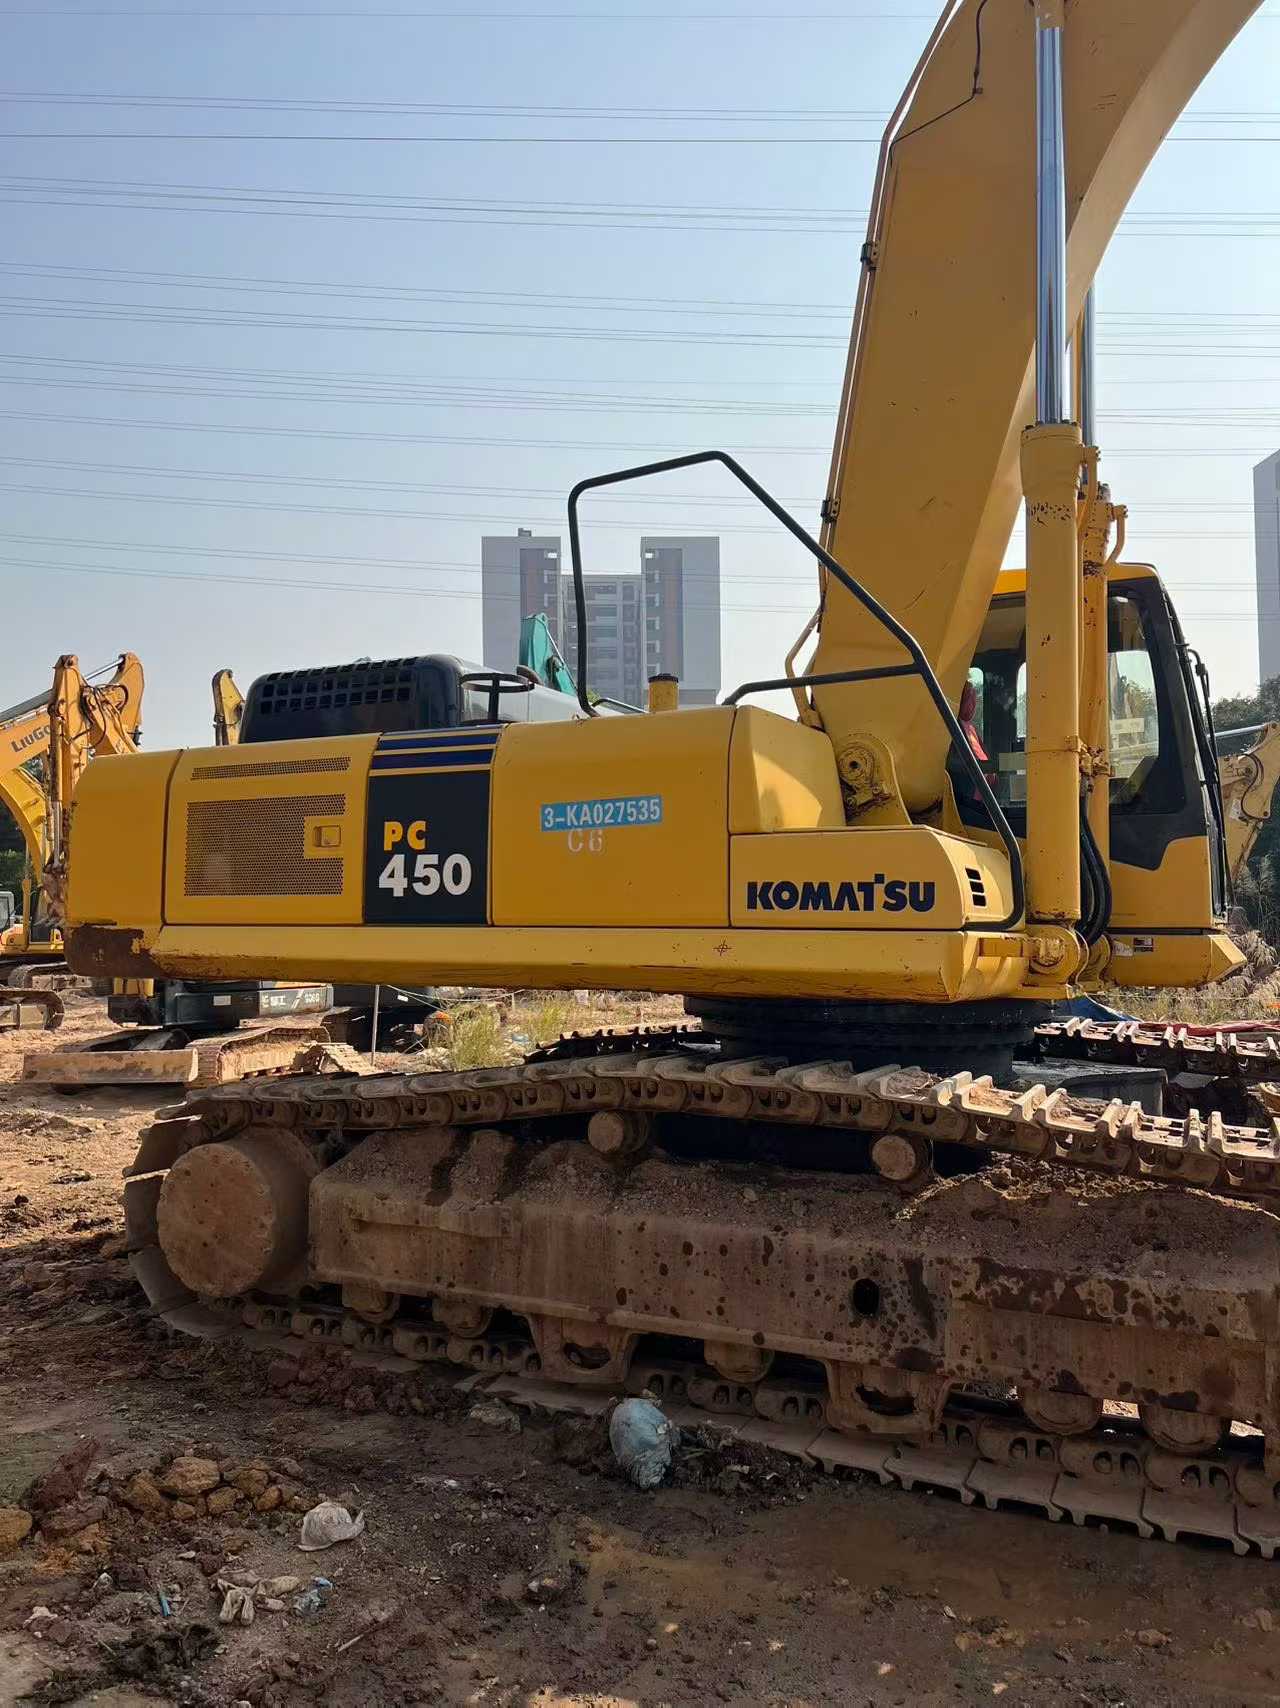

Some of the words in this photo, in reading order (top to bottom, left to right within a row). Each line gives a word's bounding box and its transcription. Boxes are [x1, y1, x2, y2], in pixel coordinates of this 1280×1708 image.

[544, 799, 661, 828] 3-KA027535
[384, 820, 426, 851] PC
[379, 853, 472, 897] 450
[747, 873, 935, 912] KOMATSU
